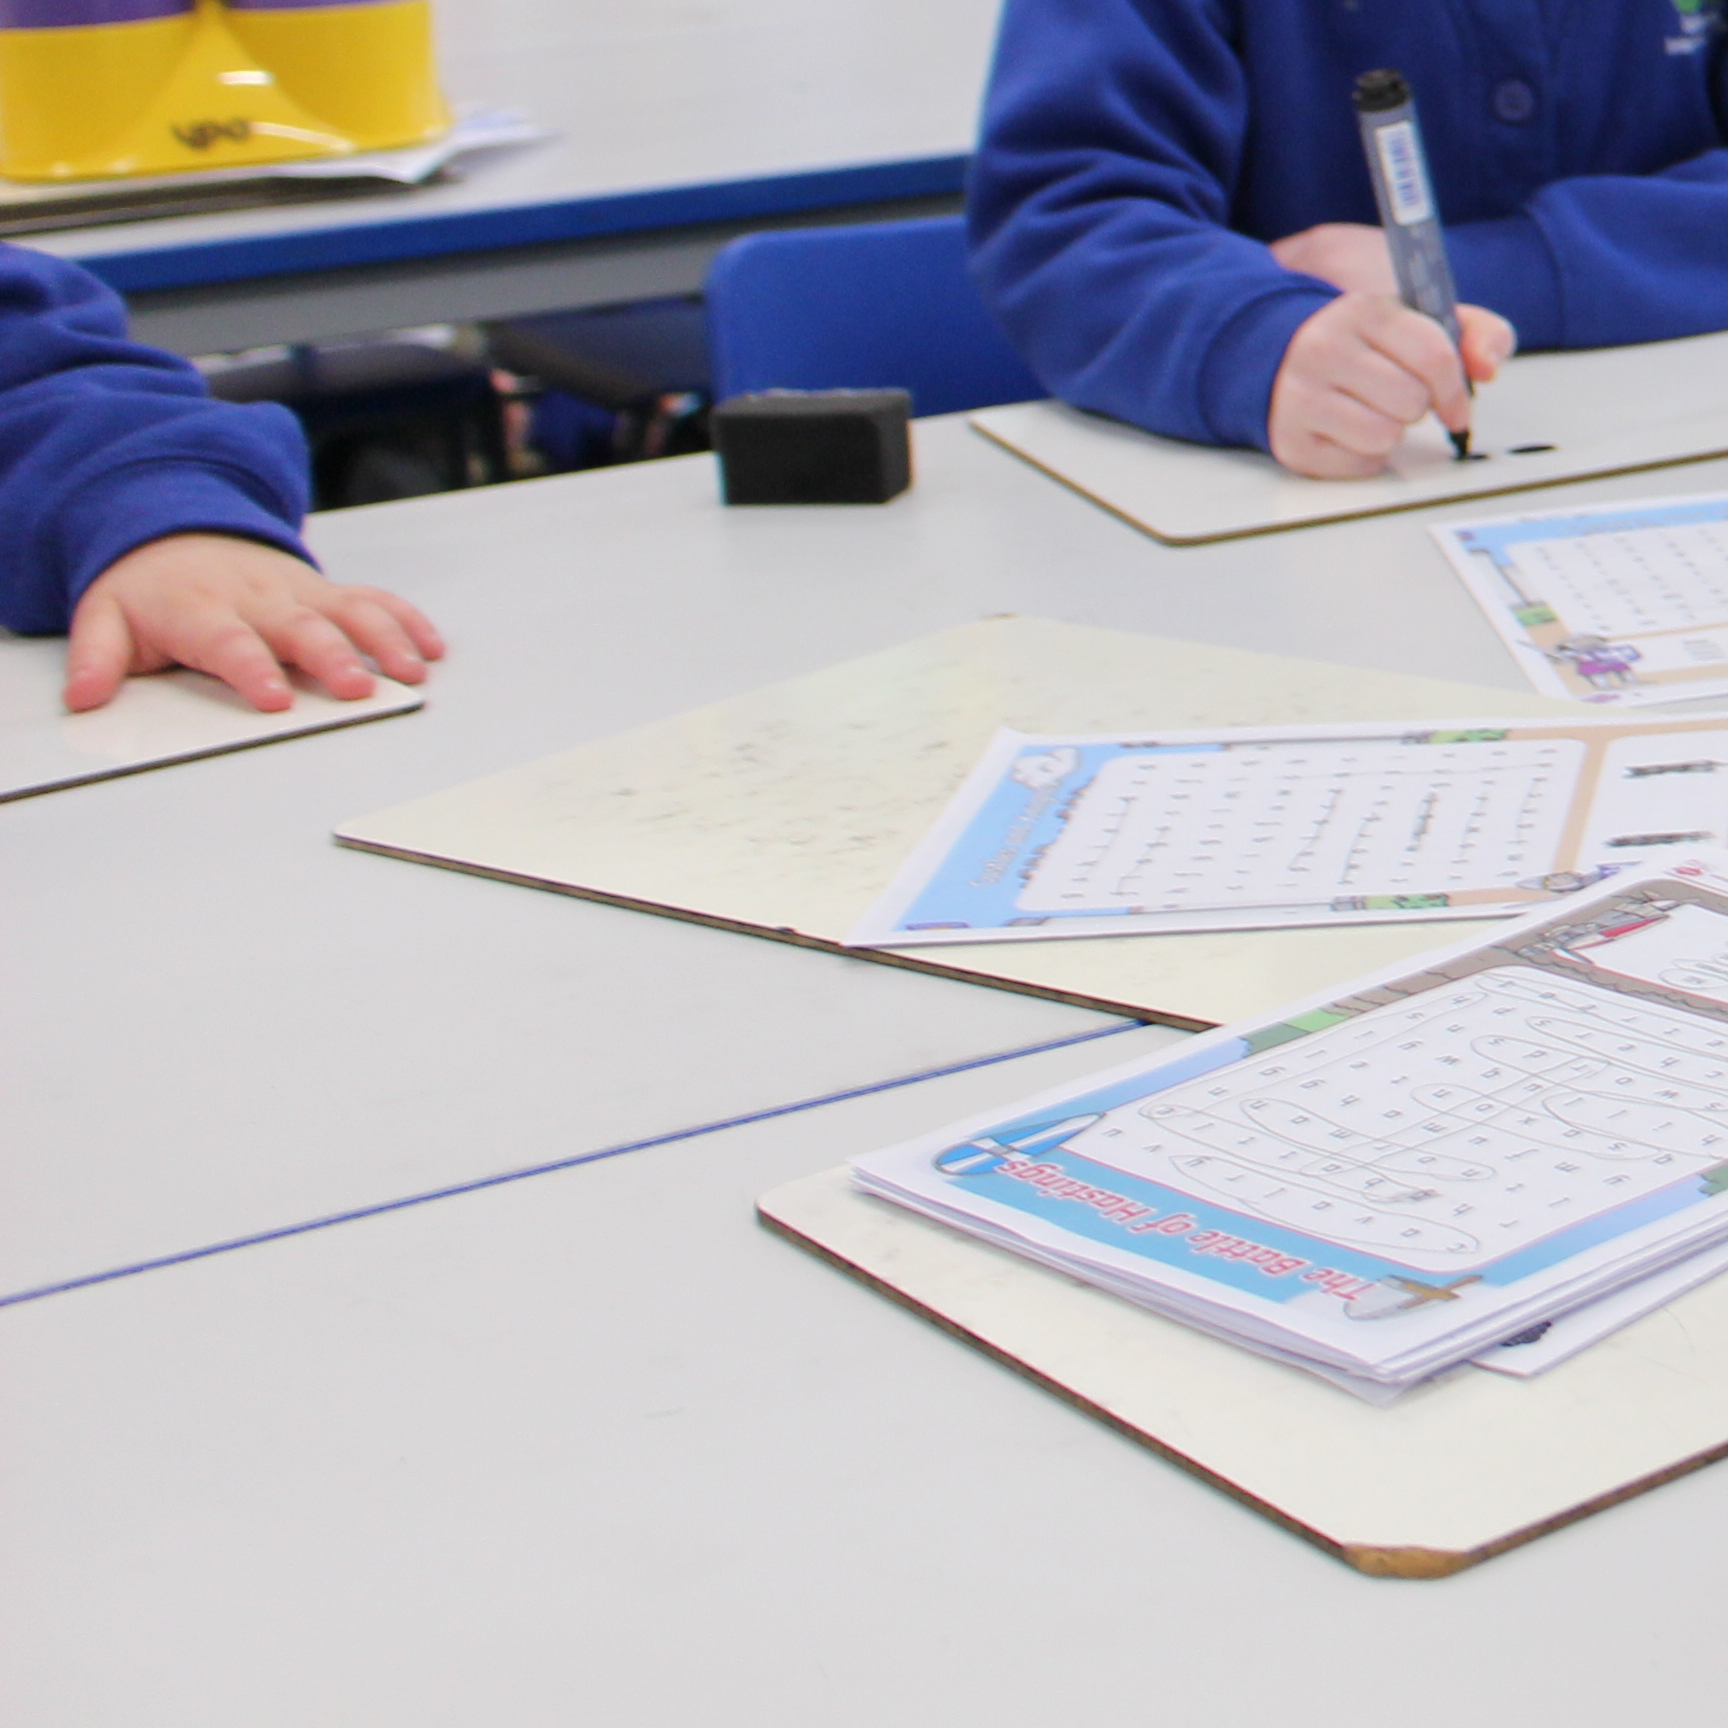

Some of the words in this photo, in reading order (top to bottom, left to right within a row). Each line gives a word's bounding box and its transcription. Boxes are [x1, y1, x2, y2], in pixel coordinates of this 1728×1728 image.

[995, 1157, 1153, 1225] Hastings
[1127, 1210, 1195, 1238] of
[1186, 1227, 1312, 1278] Battle
[1315, 1265, 1382, 1302] The
